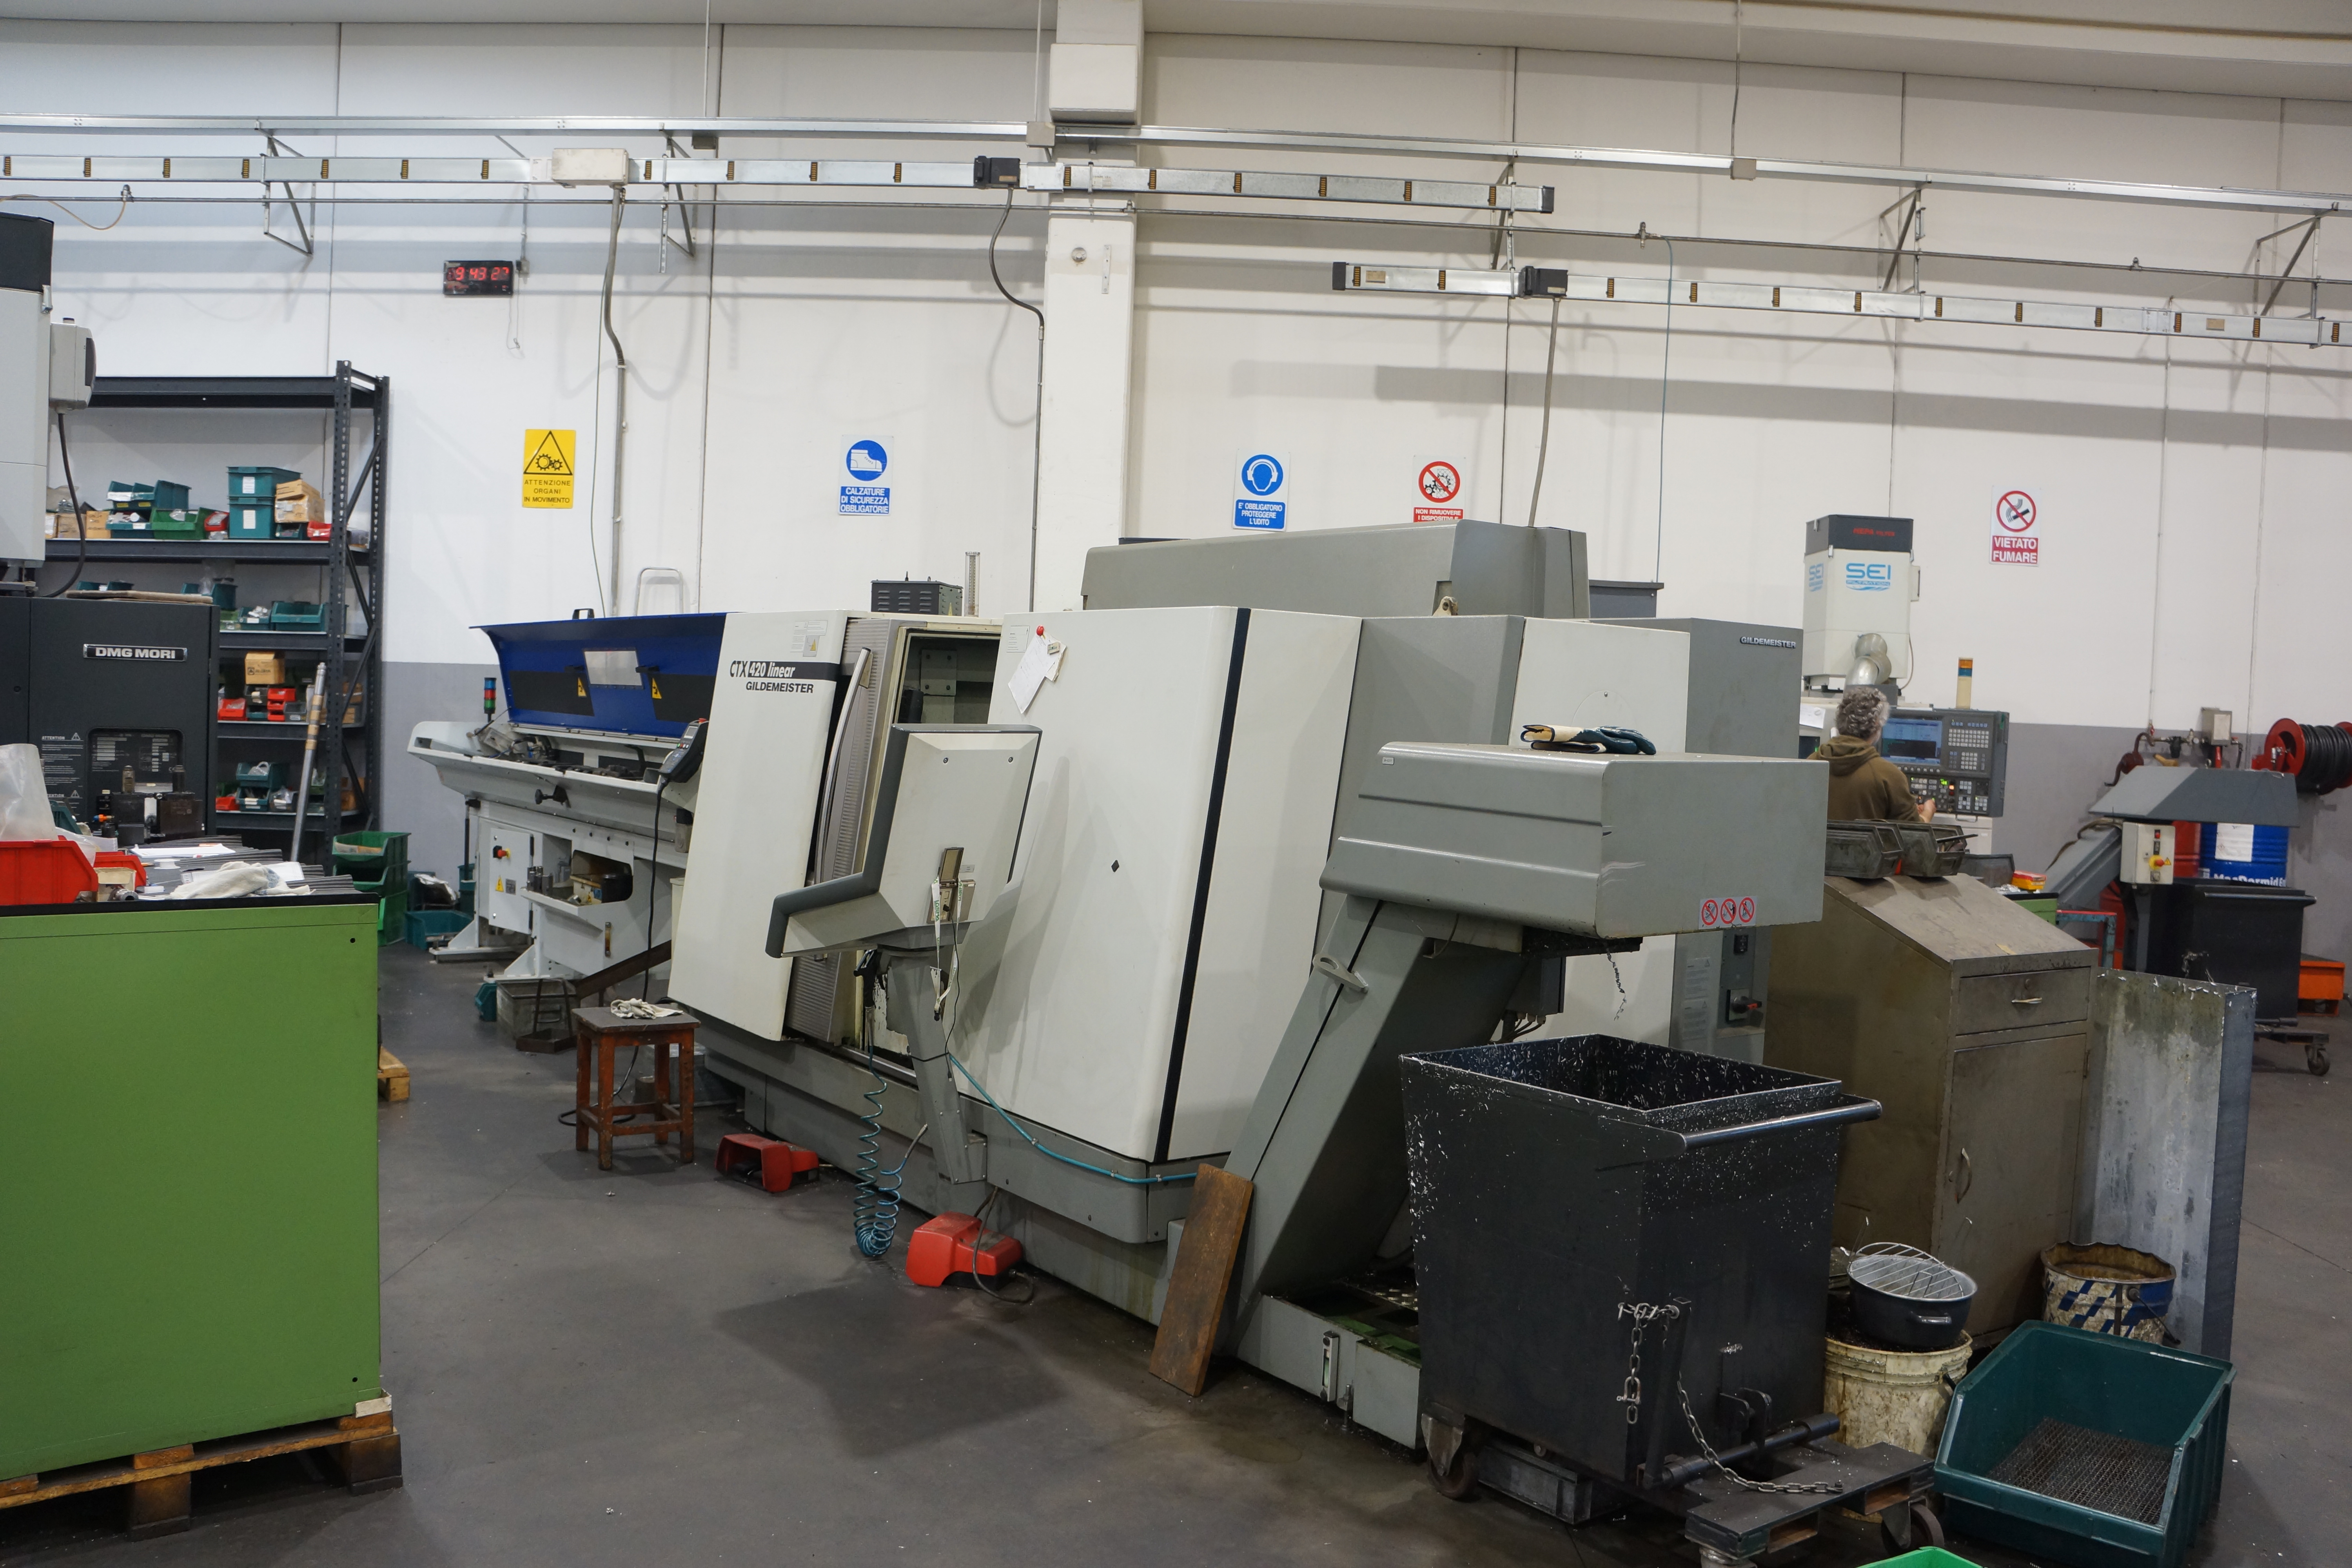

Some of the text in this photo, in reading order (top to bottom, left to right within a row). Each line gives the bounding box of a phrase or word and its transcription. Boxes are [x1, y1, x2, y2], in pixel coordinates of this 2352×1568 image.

[846, 488, 885, 496] CALZATURE
[850, 496, 888, 505] SICUREZZA
[840, 505, 889, 513] OBBLIGATORIE
[1245, 503, 1282, 512] OBBLIGATORIO
[1994, 536, 2037, 550] VIETATO
[1993, 550, 2037, 563] FUMARE
[1846, 563, 1891, 580] SEI
[1740, 636, 1796, 648] GILDEMEISTER
[95, 647, 175, 659] DMG MORI
[730, 660, 796, 677] CTX 420 linear
[746, 681, 814, 693] GILDEMEISTER
